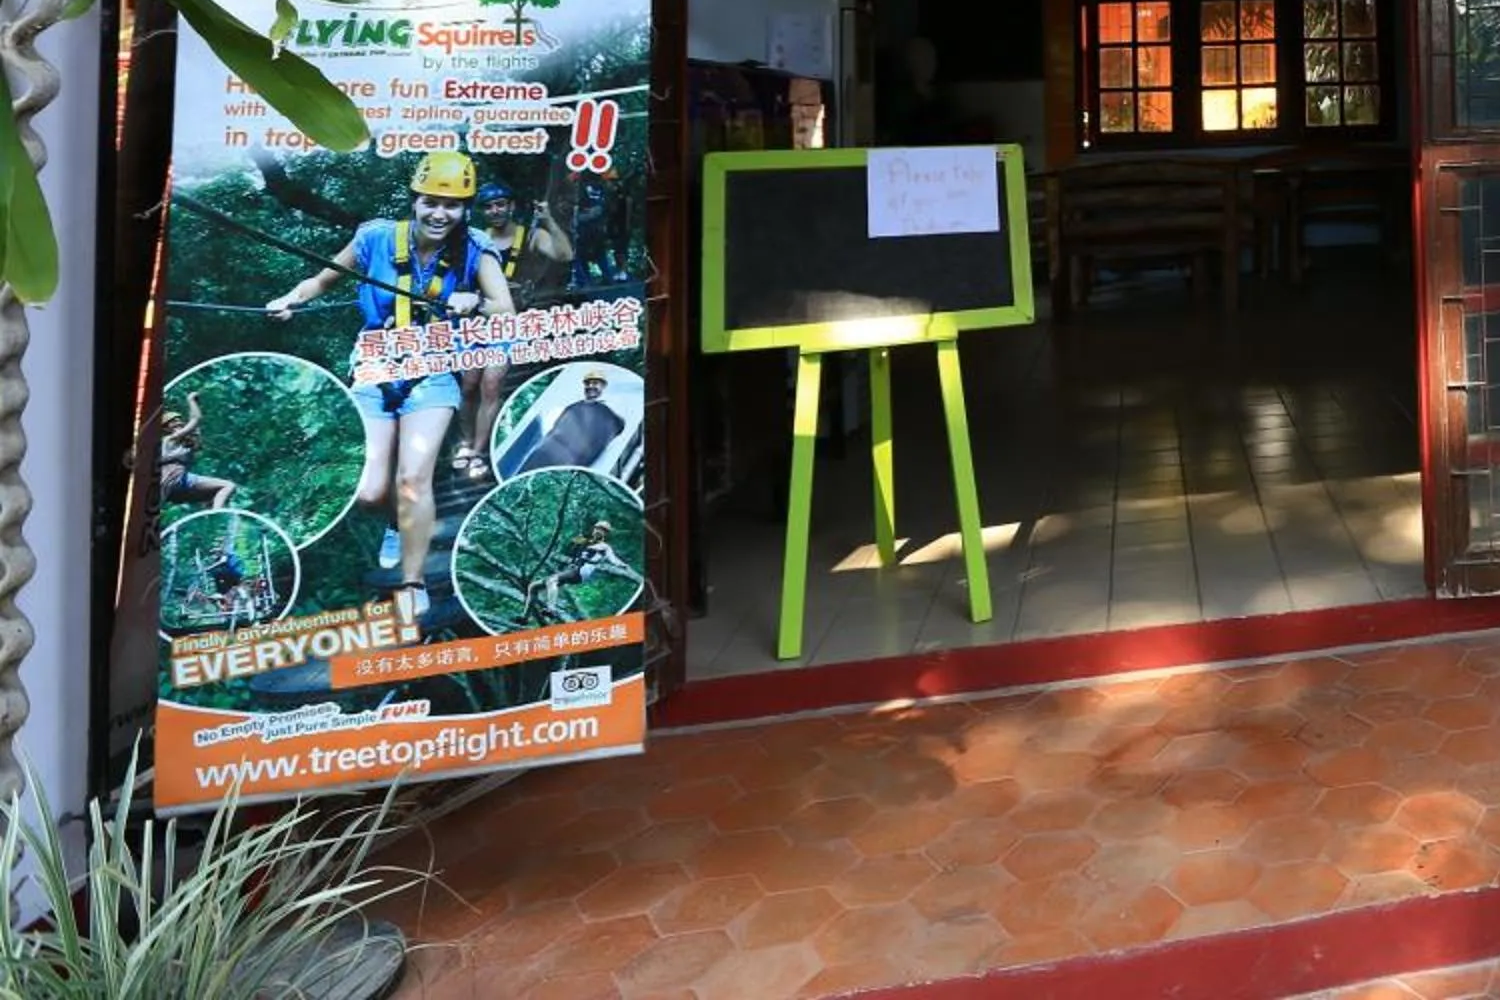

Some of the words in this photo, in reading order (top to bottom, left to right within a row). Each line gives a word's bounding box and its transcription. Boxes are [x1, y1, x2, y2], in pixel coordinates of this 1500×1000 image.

[423, 56, 442, 71] by
[451, 56, 478, 69] the
[487, 55, 538, 71] flights
[337, 81, 376, 98] ore
[391, 77, 428, 98] fun
[445, 80, 543, 100] Extreme
[225, 101, 266, 116] with
[474, 106, 572, 124] guarantee
[225, 126, 248, 147] in
[382, 133, 455, 155] green
[470, 130, 546, 150] forest
[360, 300, 639, 357] 最高最长的森林峡谷
[174, 633, 228, 653] Finally
[271, 609, 359, 635] Adventure
[366, 601, 391, 616] for
[174, 591, 419, 687] EVERYONE!
[197, 732, 218, 744] No
[221, 720, 265, 739] Empty
[296, 720, 328, 733] Pure
[332, 713, 377, 730] Simple
[381, 702, 428, 720] FUN!
[195, 715, 598, 787] www.treetopflight.com
